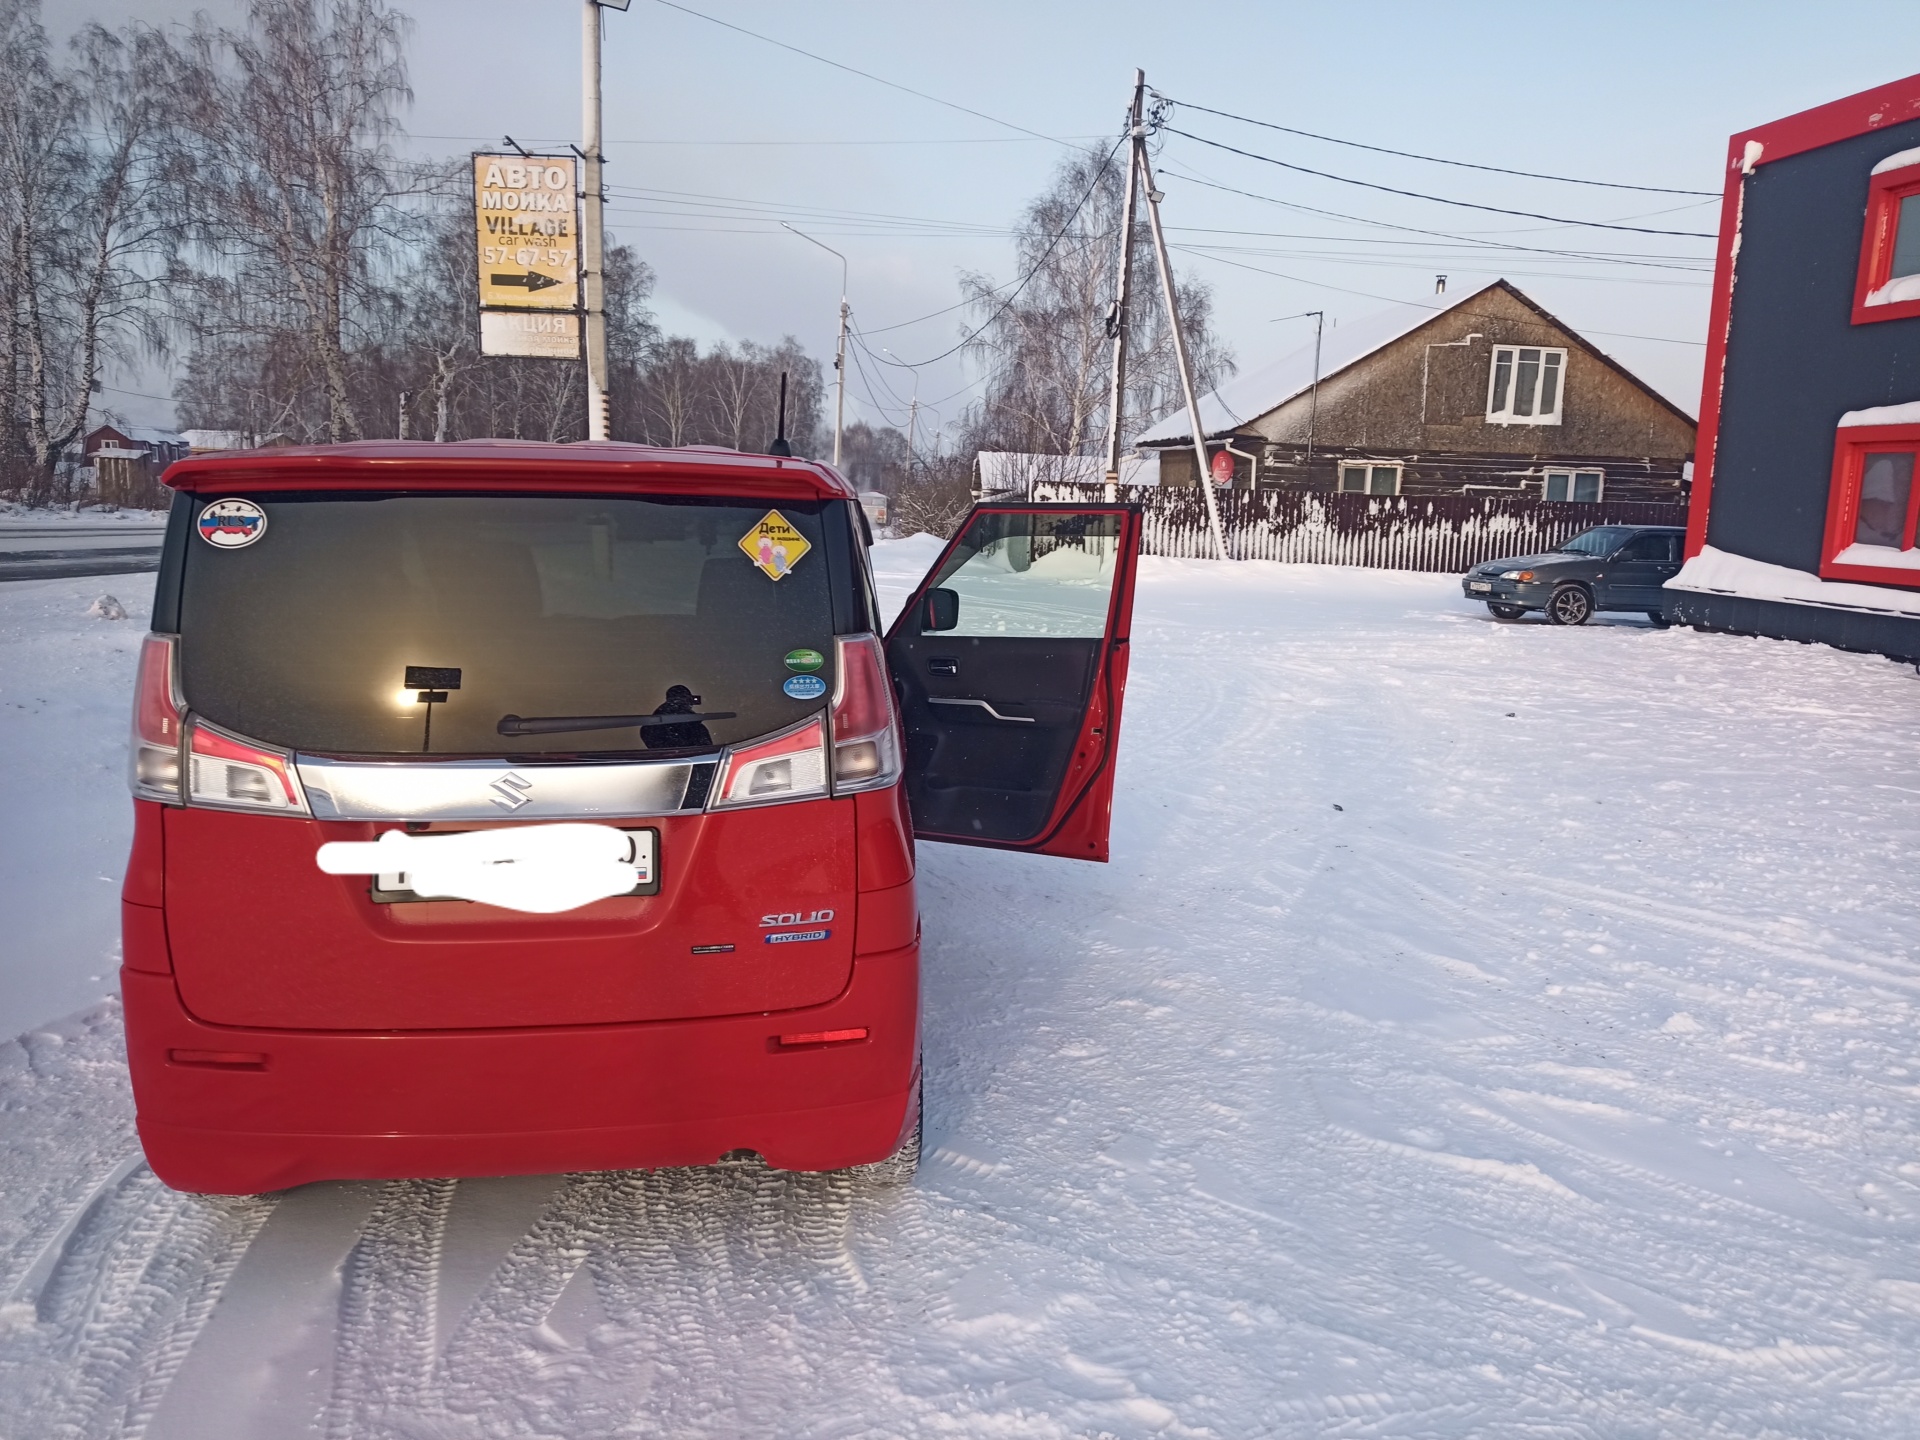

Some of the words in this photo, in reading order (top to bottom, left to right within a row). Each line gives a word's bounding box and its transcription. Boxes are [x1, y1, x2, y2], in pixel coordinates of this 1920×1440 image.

[483, 163, 567, 191] АВТО
[485, 215, 568, 238] VILLAGE
[498, 236, 519, 246] car
[524, 237, 557, 247] wash
[218, 515, 246, 527] RUS
[759, 522, 791, 535] Дети
[759, 909, 834, 928] SOLIO
[774, 931, 822, 942] HYBRID
